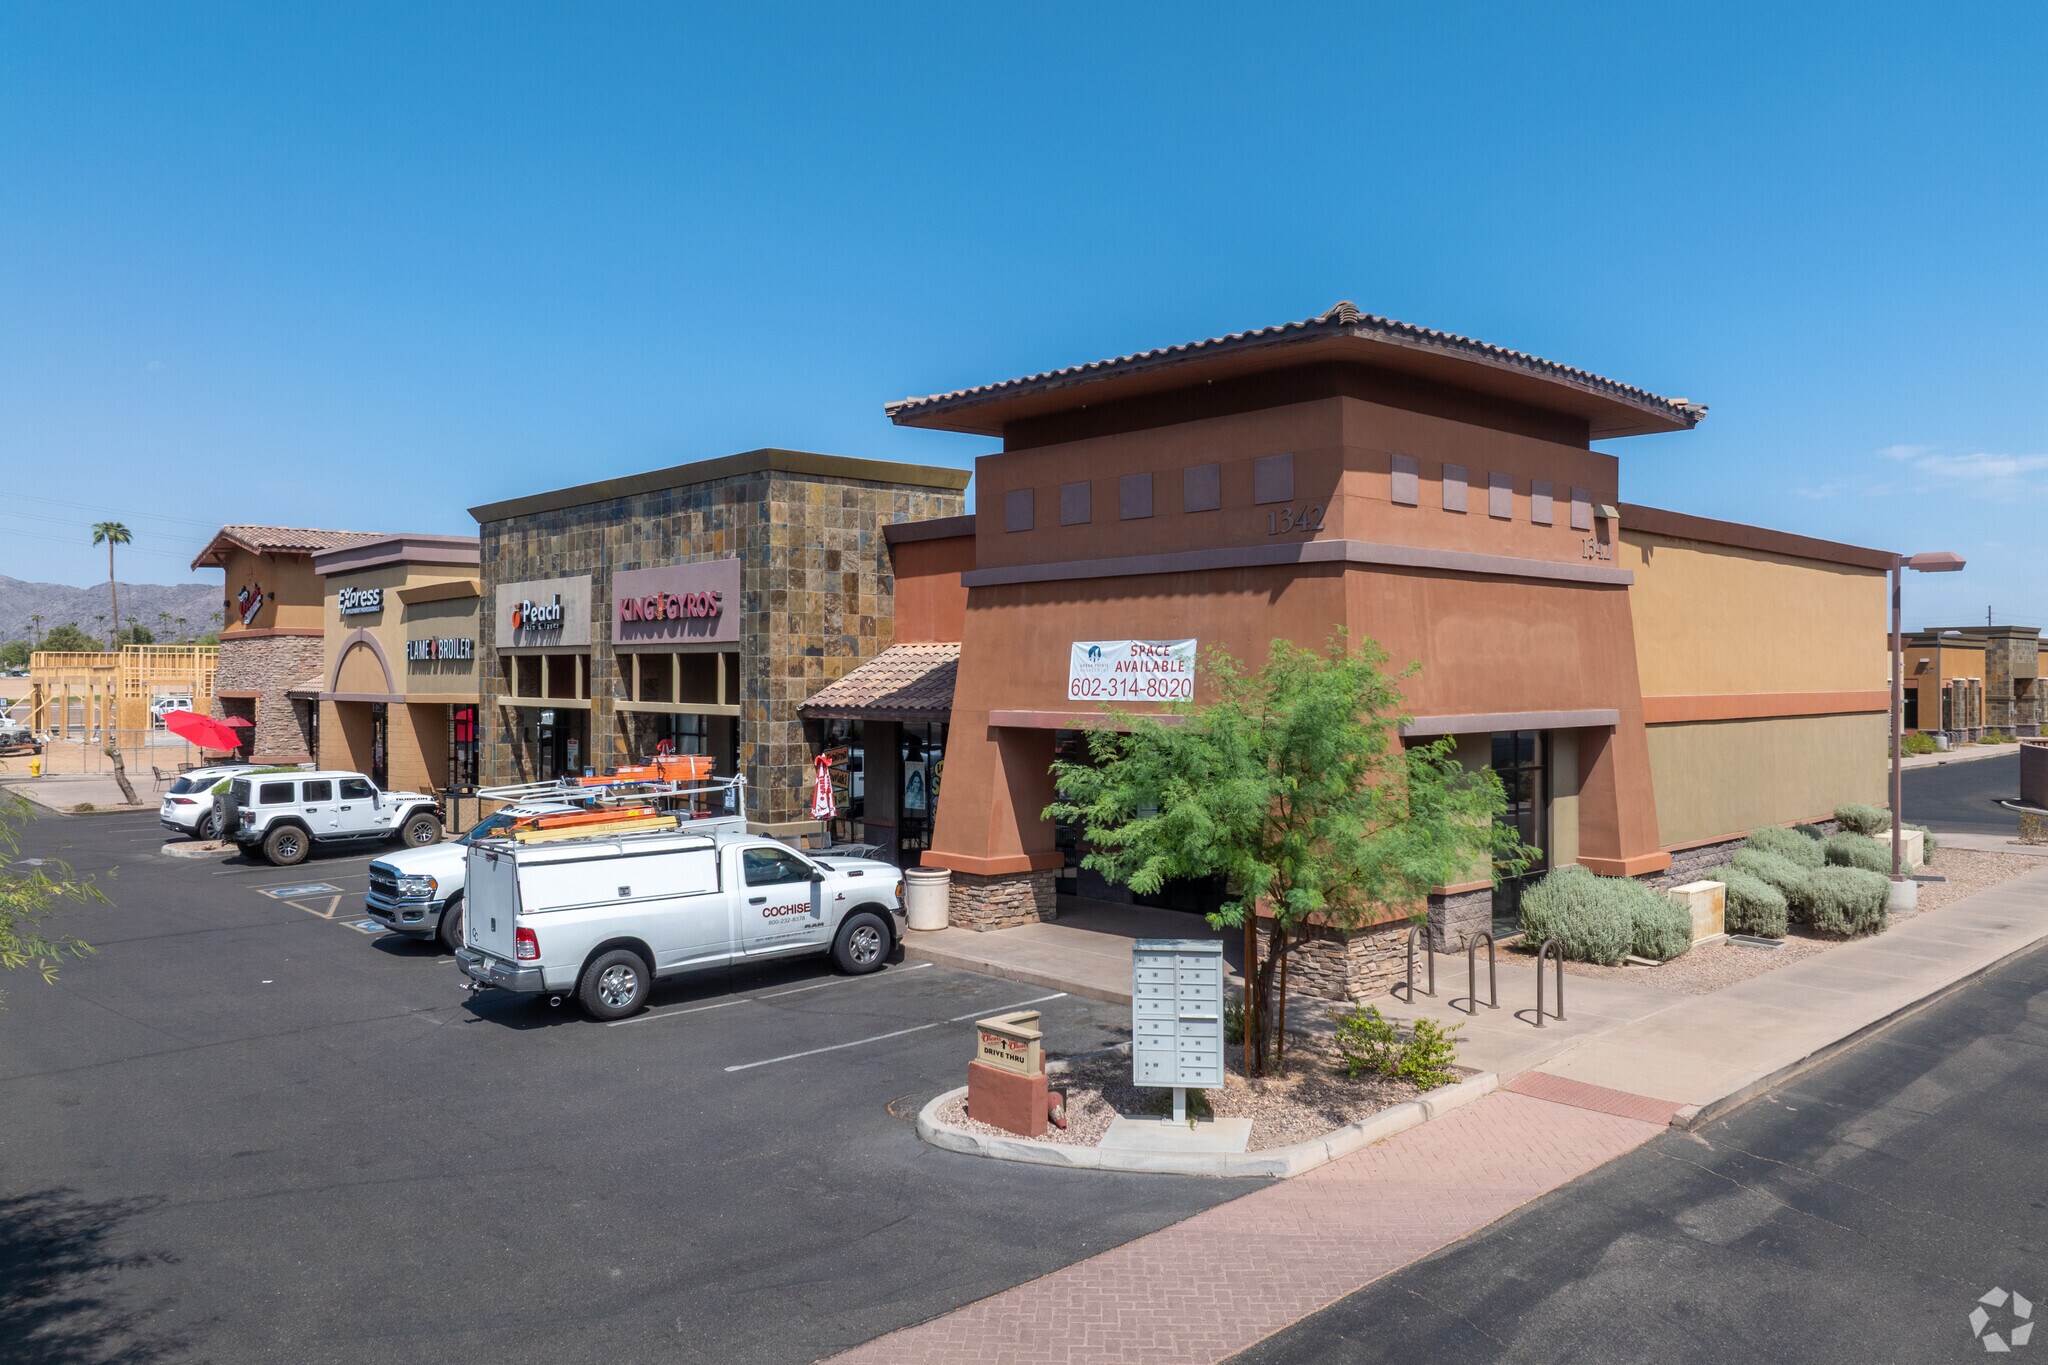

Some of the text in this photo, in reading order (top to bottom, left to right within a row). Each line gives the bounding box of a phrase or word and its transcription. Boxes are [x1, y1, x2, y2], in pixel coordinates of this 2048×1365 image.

[1267, 503, 1325, 536] 1342
[523, 594, 561, 622] Peach
[620, 590, 718, 621] KING GYROS
[406, 638, 471, 660] FLAME BROILER
[1130, 644, 1172, 657] SPACE
[1114, 660, 1185, 673] AVAILABLE
[1071, 677, 1192, 698] 602-314-8020
[762, 902, 811, 918] COCHISE
[768, 915, 806, 925] 800-232-8378
[984, 1047, 1025, 1064] DRIVE THRU
